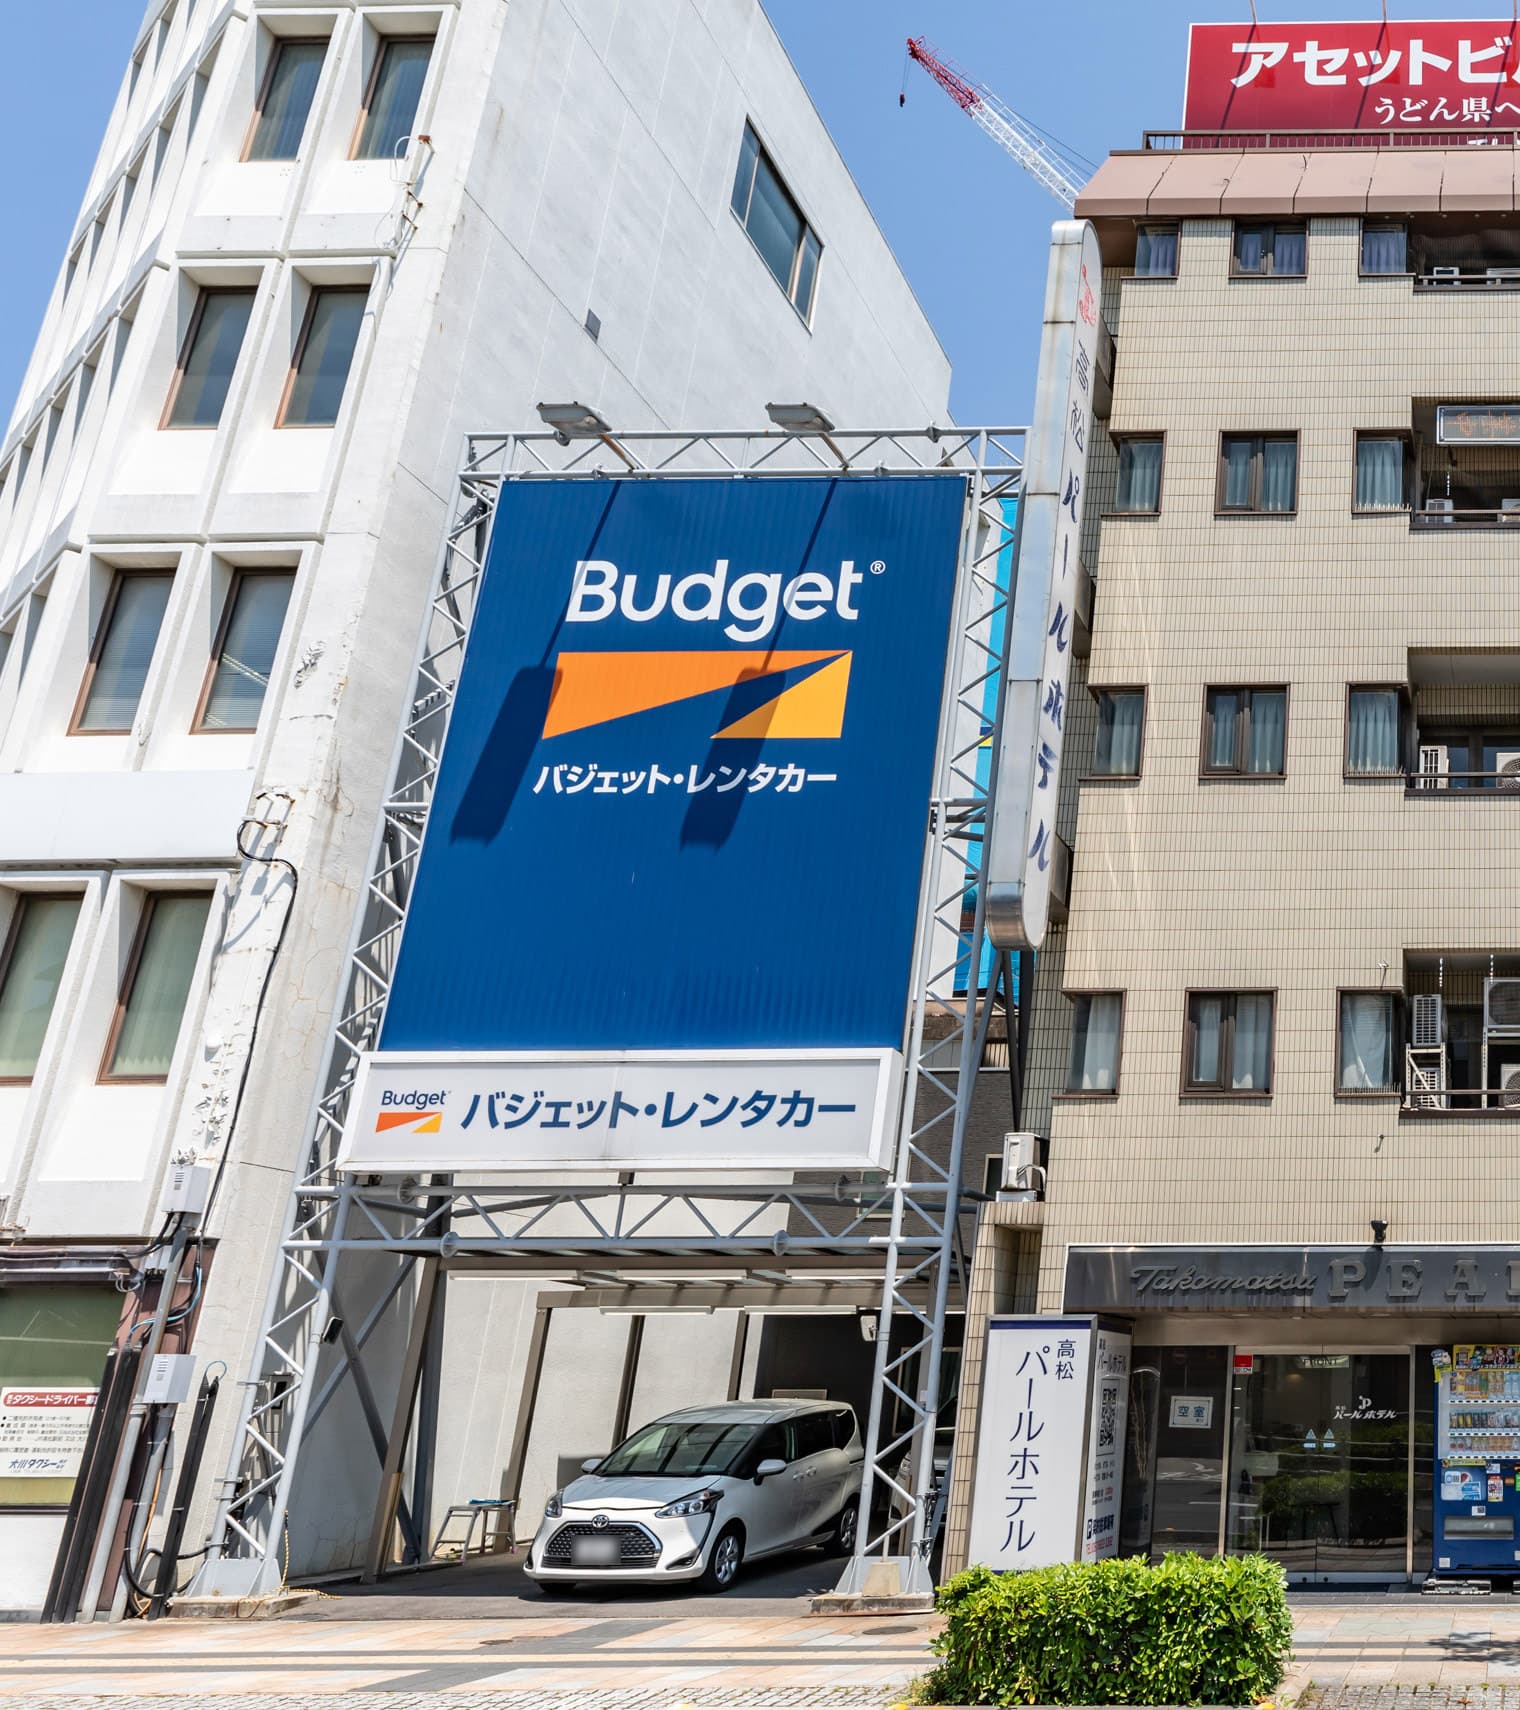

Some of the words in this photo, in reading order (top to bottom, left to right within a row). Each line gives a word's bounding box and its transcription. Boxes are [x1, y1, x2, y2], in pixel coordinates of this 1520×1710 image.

[533, 762, 838, 795] バジェット・レンタカー
[381, 1090, 448, 1111] Budget
[460, 1089, 856, 1130] バジェット・レンタカー
[1129, 1264, 1320, 1298] Takamatsu
[1056, 1338, 1076, 1382] 高松
[1000, 1346, 1051, 1554] パールホテル
